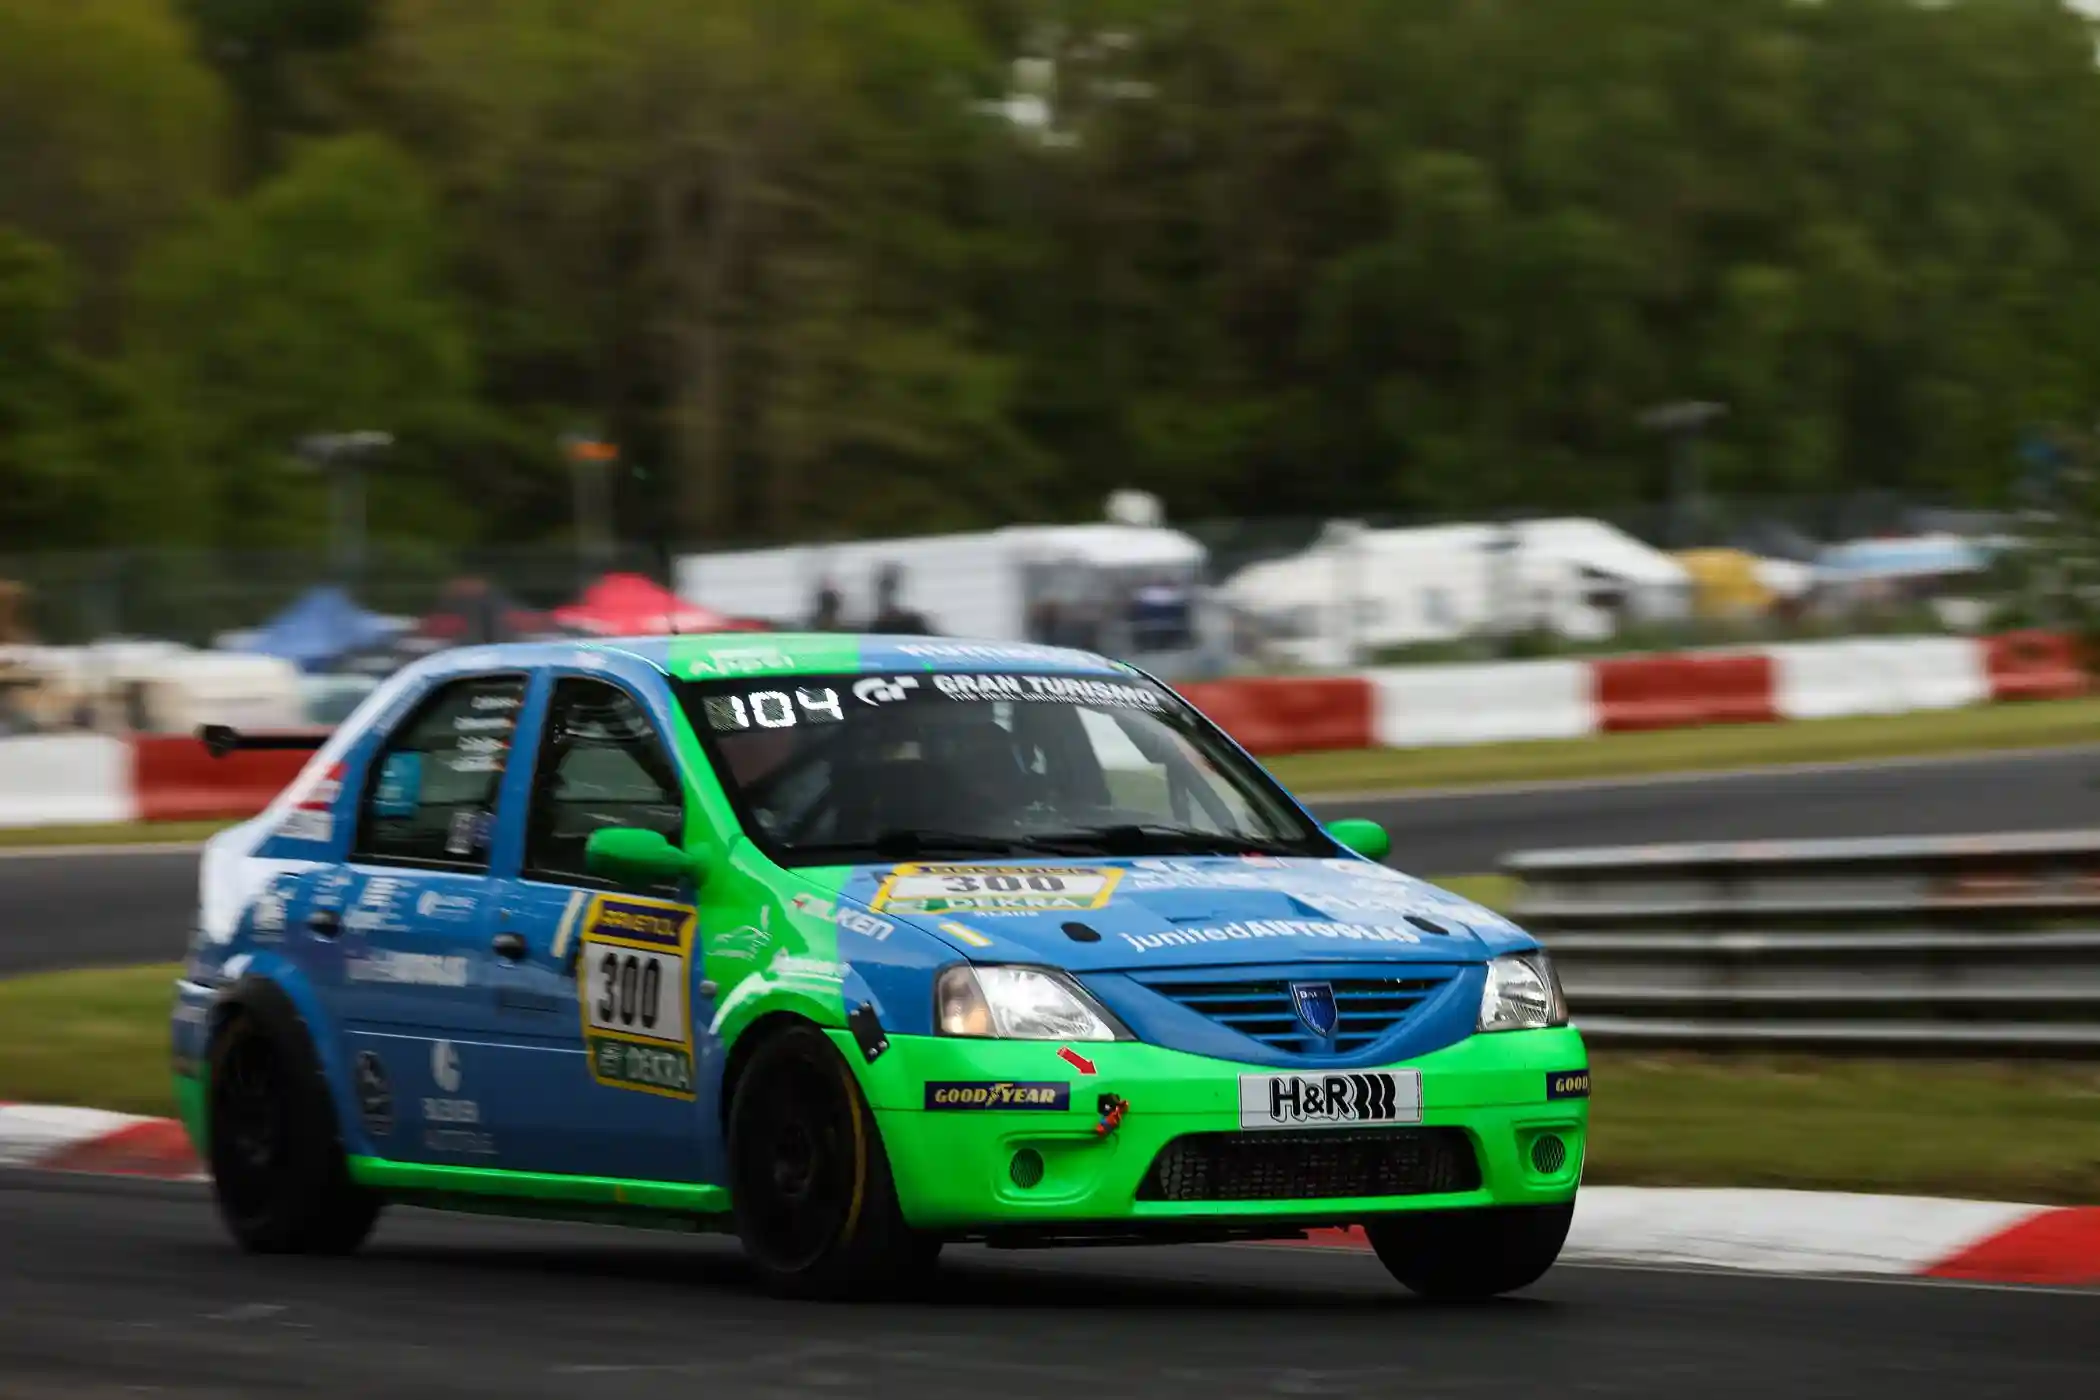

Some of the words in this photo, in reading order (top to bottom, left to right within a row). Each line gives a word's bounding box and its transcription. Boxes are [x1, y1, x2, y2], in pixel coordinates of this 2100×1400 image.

[932, 674, 1023, 694] GRAN
[1022, 675, 1160, 707] TURISMO
[731, 686, 844, 729] 104
[943, 875, 1066, 893] 300
[947, 896, 1085, 909] DEKRA
[598, 951, 662, 1030] 300
